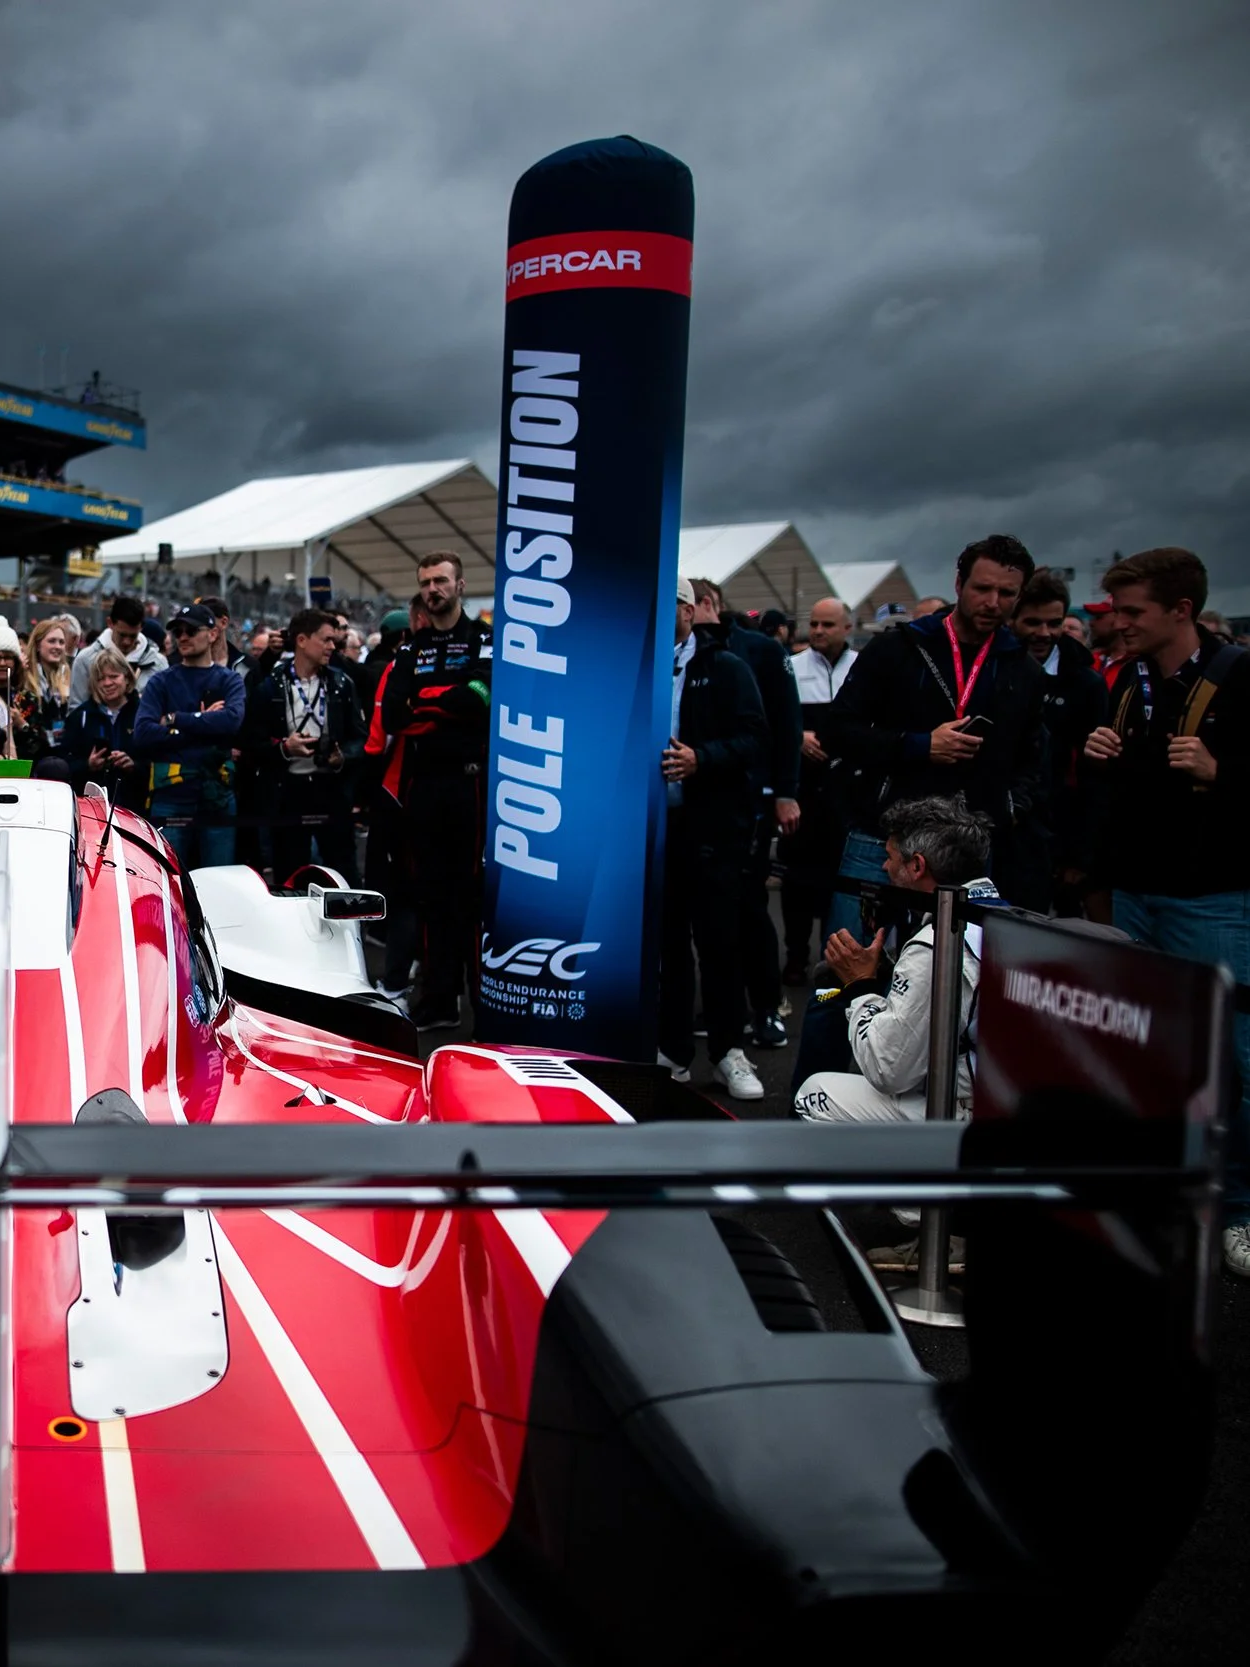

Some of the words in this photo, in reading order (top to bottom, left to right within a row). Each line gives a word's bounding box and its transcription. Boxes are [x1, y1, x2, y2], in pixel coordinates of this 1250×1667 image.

[507, 250, 642, 287] YPERCAR
[502, 350, 580, 676] POSITION
[494, 704, 564, 881] POLE
[481, 932, 602, 981] WEC
[506, 982, 586, 1000] ENDURANCE
[1029, 973, 1152, 1047] RACEBORN
[794, 1091, 830, 1112] TER
